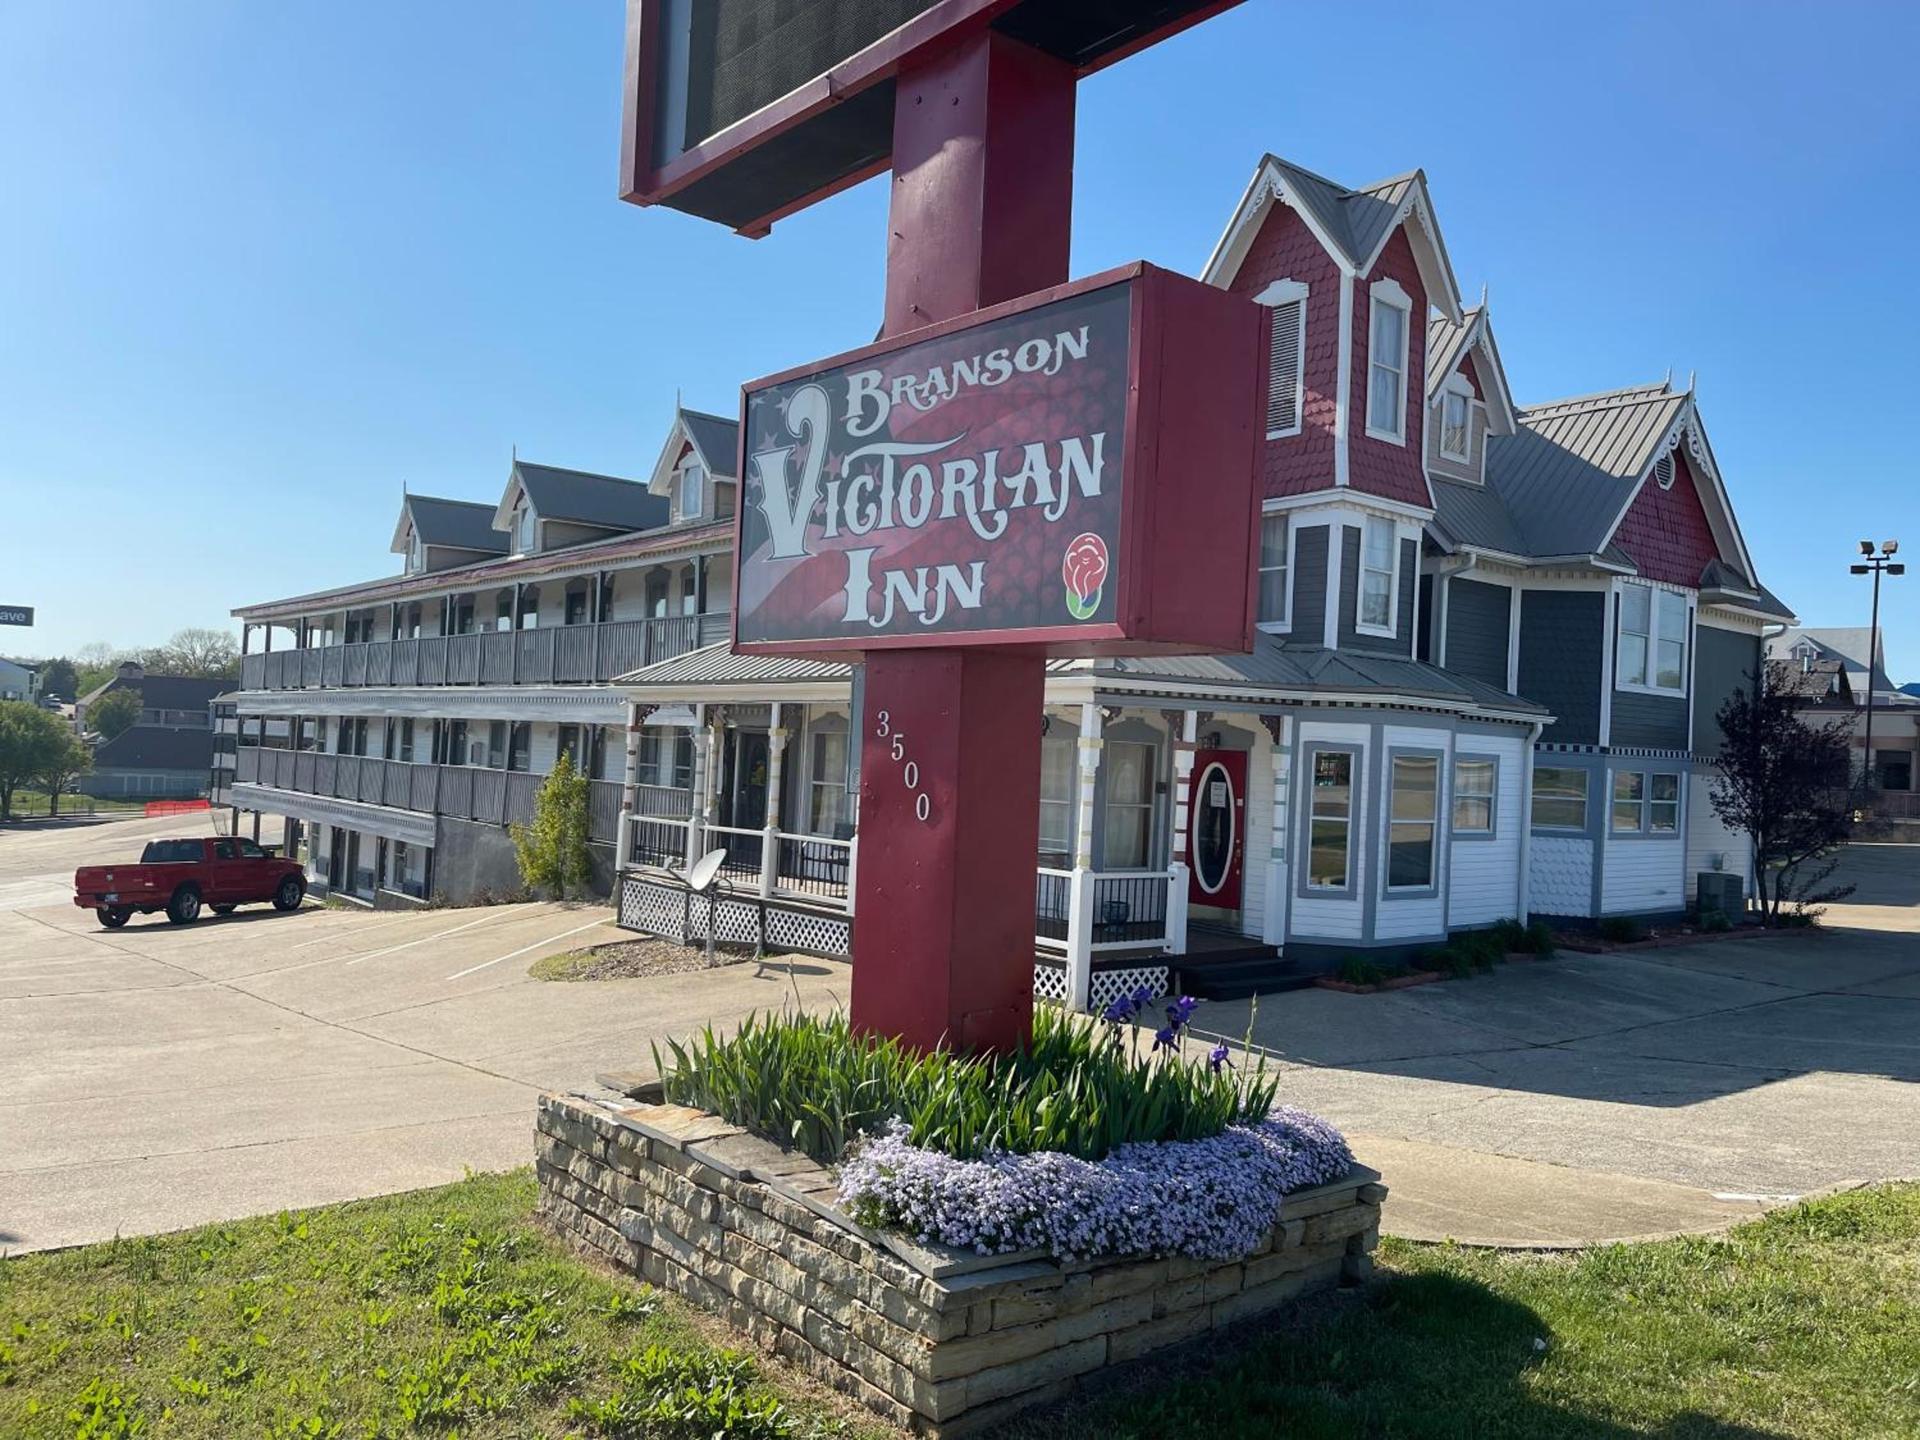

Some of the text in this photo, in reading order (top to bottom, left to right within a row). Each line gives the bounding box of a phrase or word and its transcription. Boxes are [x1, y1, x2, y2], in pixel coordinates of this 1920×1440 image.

[844, 326, 1090, 436] BRANSON
[754, 383, 1105, 561] VICTORIAN
[842, 547, 986, 627] INN
[876, 710, 930, 821] 3500
